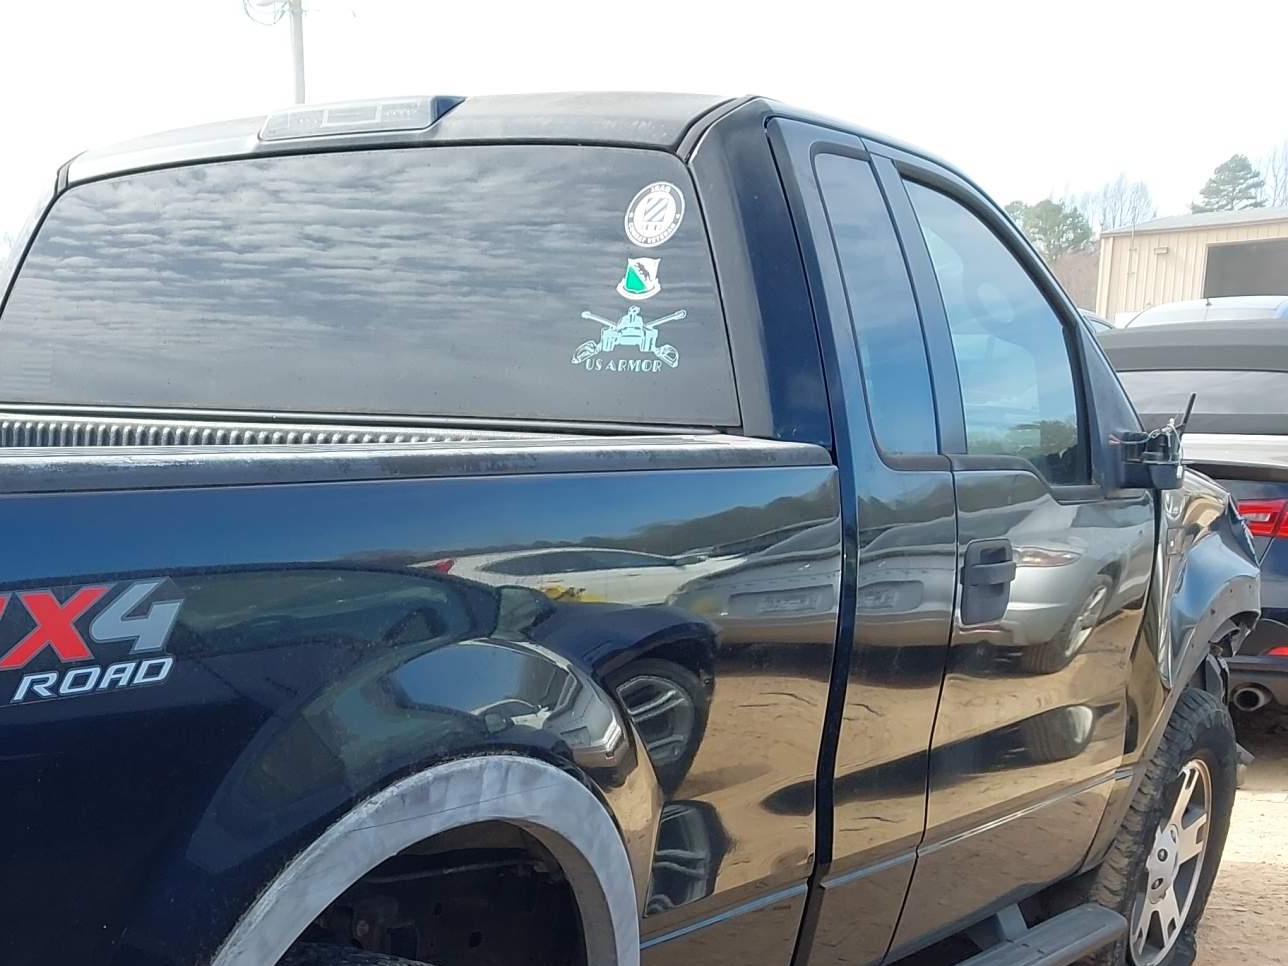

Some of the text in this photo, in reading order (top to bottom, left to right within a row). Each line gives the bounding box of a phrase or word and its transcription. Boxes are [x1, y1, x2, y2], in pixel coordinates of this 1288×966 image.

[585, 358, 663, 373] US ARMOR
[12, 658, 174, 703] ROAD
